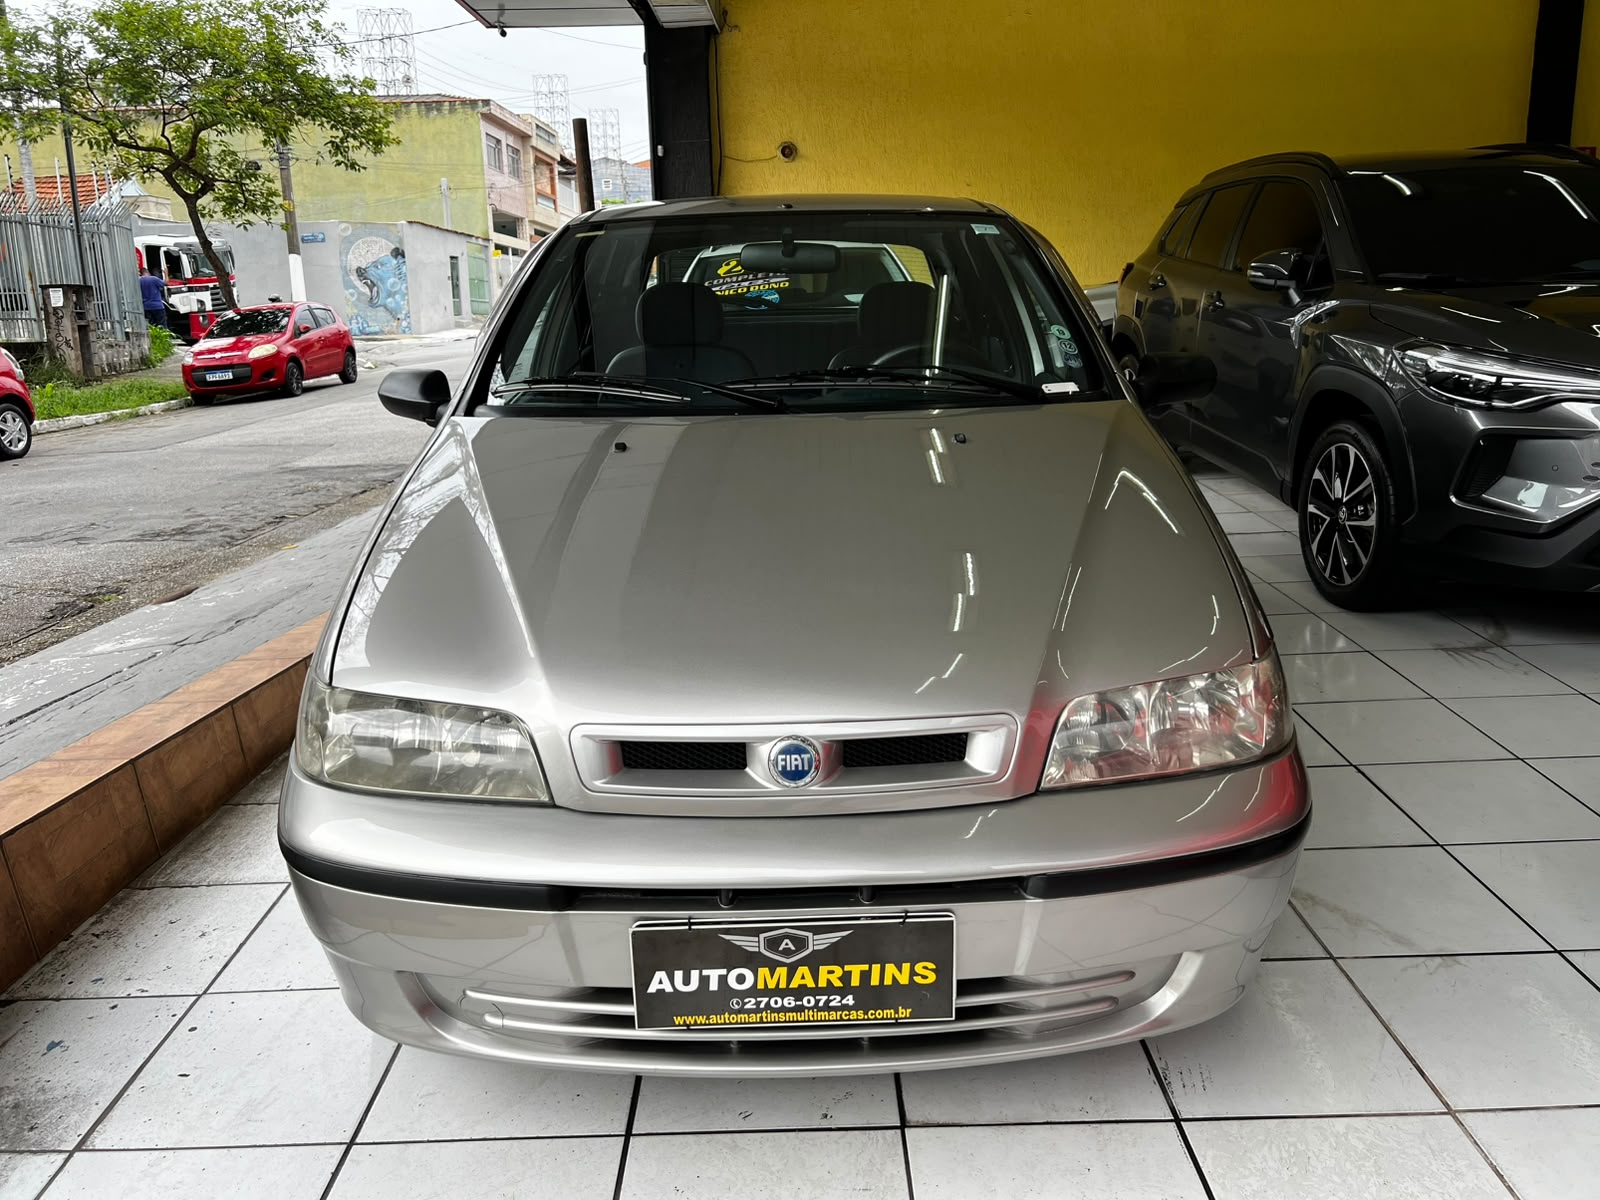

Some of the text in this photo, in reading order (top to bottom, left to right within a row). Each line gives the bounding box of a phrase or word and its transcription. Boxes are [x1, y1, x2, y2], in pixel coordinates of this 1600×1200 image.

[715, 285, 748, 296] NICO
[777, 753, 811, 771] FIAT
[778, 938, 796, 951] A
[646, 961, 937, 993] AUTOMARTINS
[743, 994, 855, 1009] 2706-0724
[673, 1006, 912, 1025] www.automartinsmultimarcas.com.br
